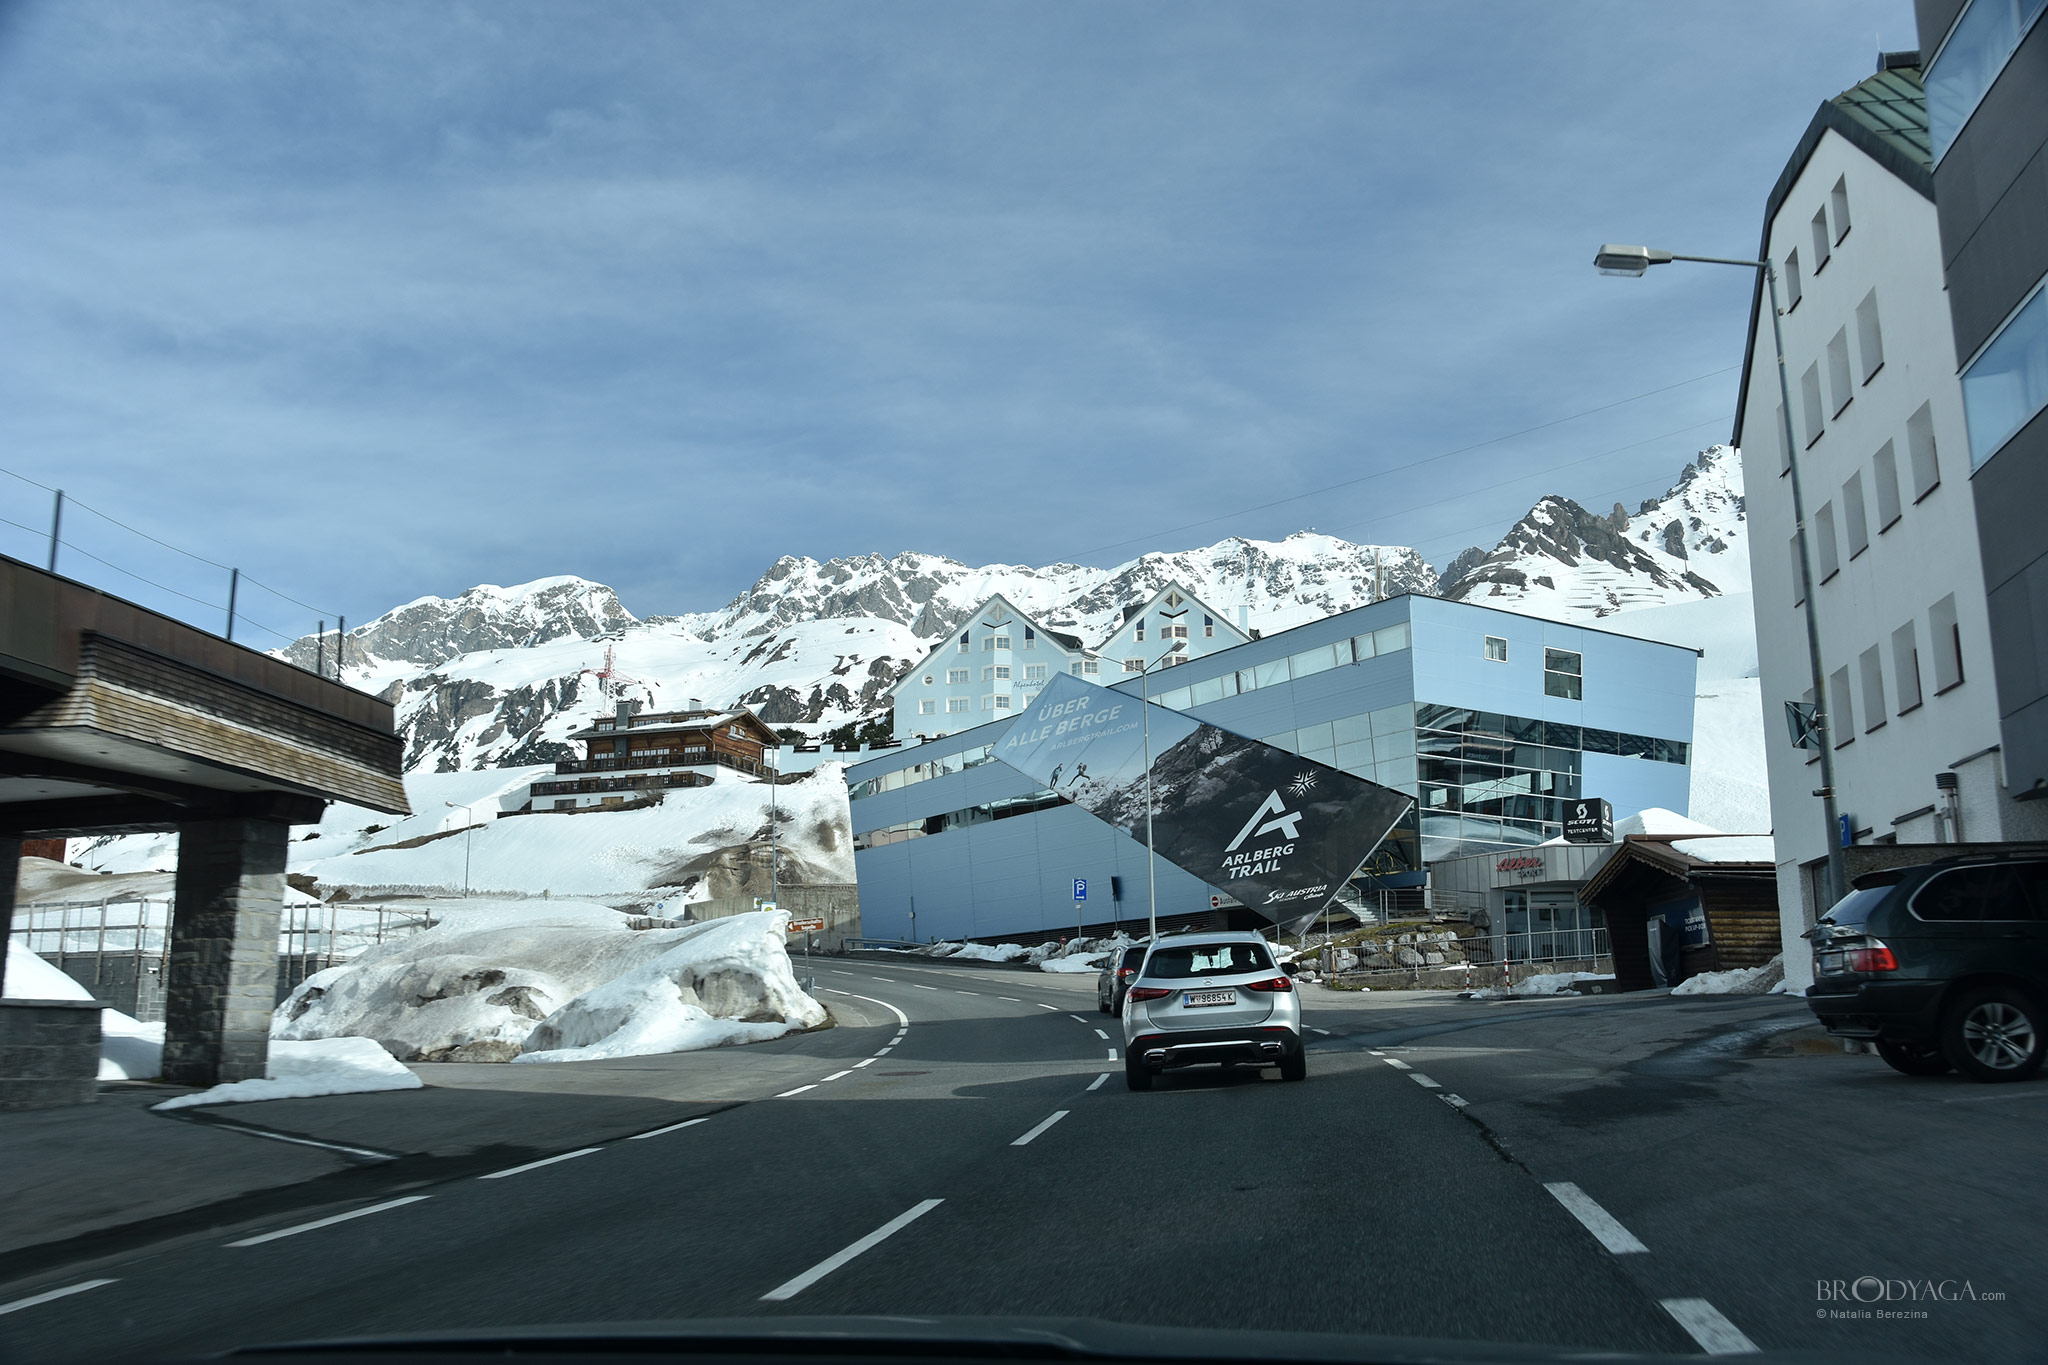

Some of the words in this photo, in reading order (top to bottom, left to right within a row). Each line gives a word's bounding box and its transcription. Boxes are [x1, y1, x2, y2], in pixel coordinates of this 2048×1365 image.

[1013, 680, 1045, 690] Alpenhotel
[1038, 696, 1090, 721] ÜBER
[1004, 725, 1053, 750] ALLE
[1055, 705, 1123, 736] BERGE
[1050, 722, 1138, 751] ARLBERGTRAIL.COM
[1567, 818, 1597, 826] SCOTT
[1567, 827, 1599, 835] TESTCENTER
[1839, 820, 1846, 841] P
[1221, 843, 1295, 868] ARLBERG
[1496, 856, 1541, 872] Alber
[1229, 859, 1281, 880] TRAIL
[1076, 883, 1086, 895] P
[1262, 889, 1286, 905] SKI
[1285, 884, 1328, 898] AUSTRIA
